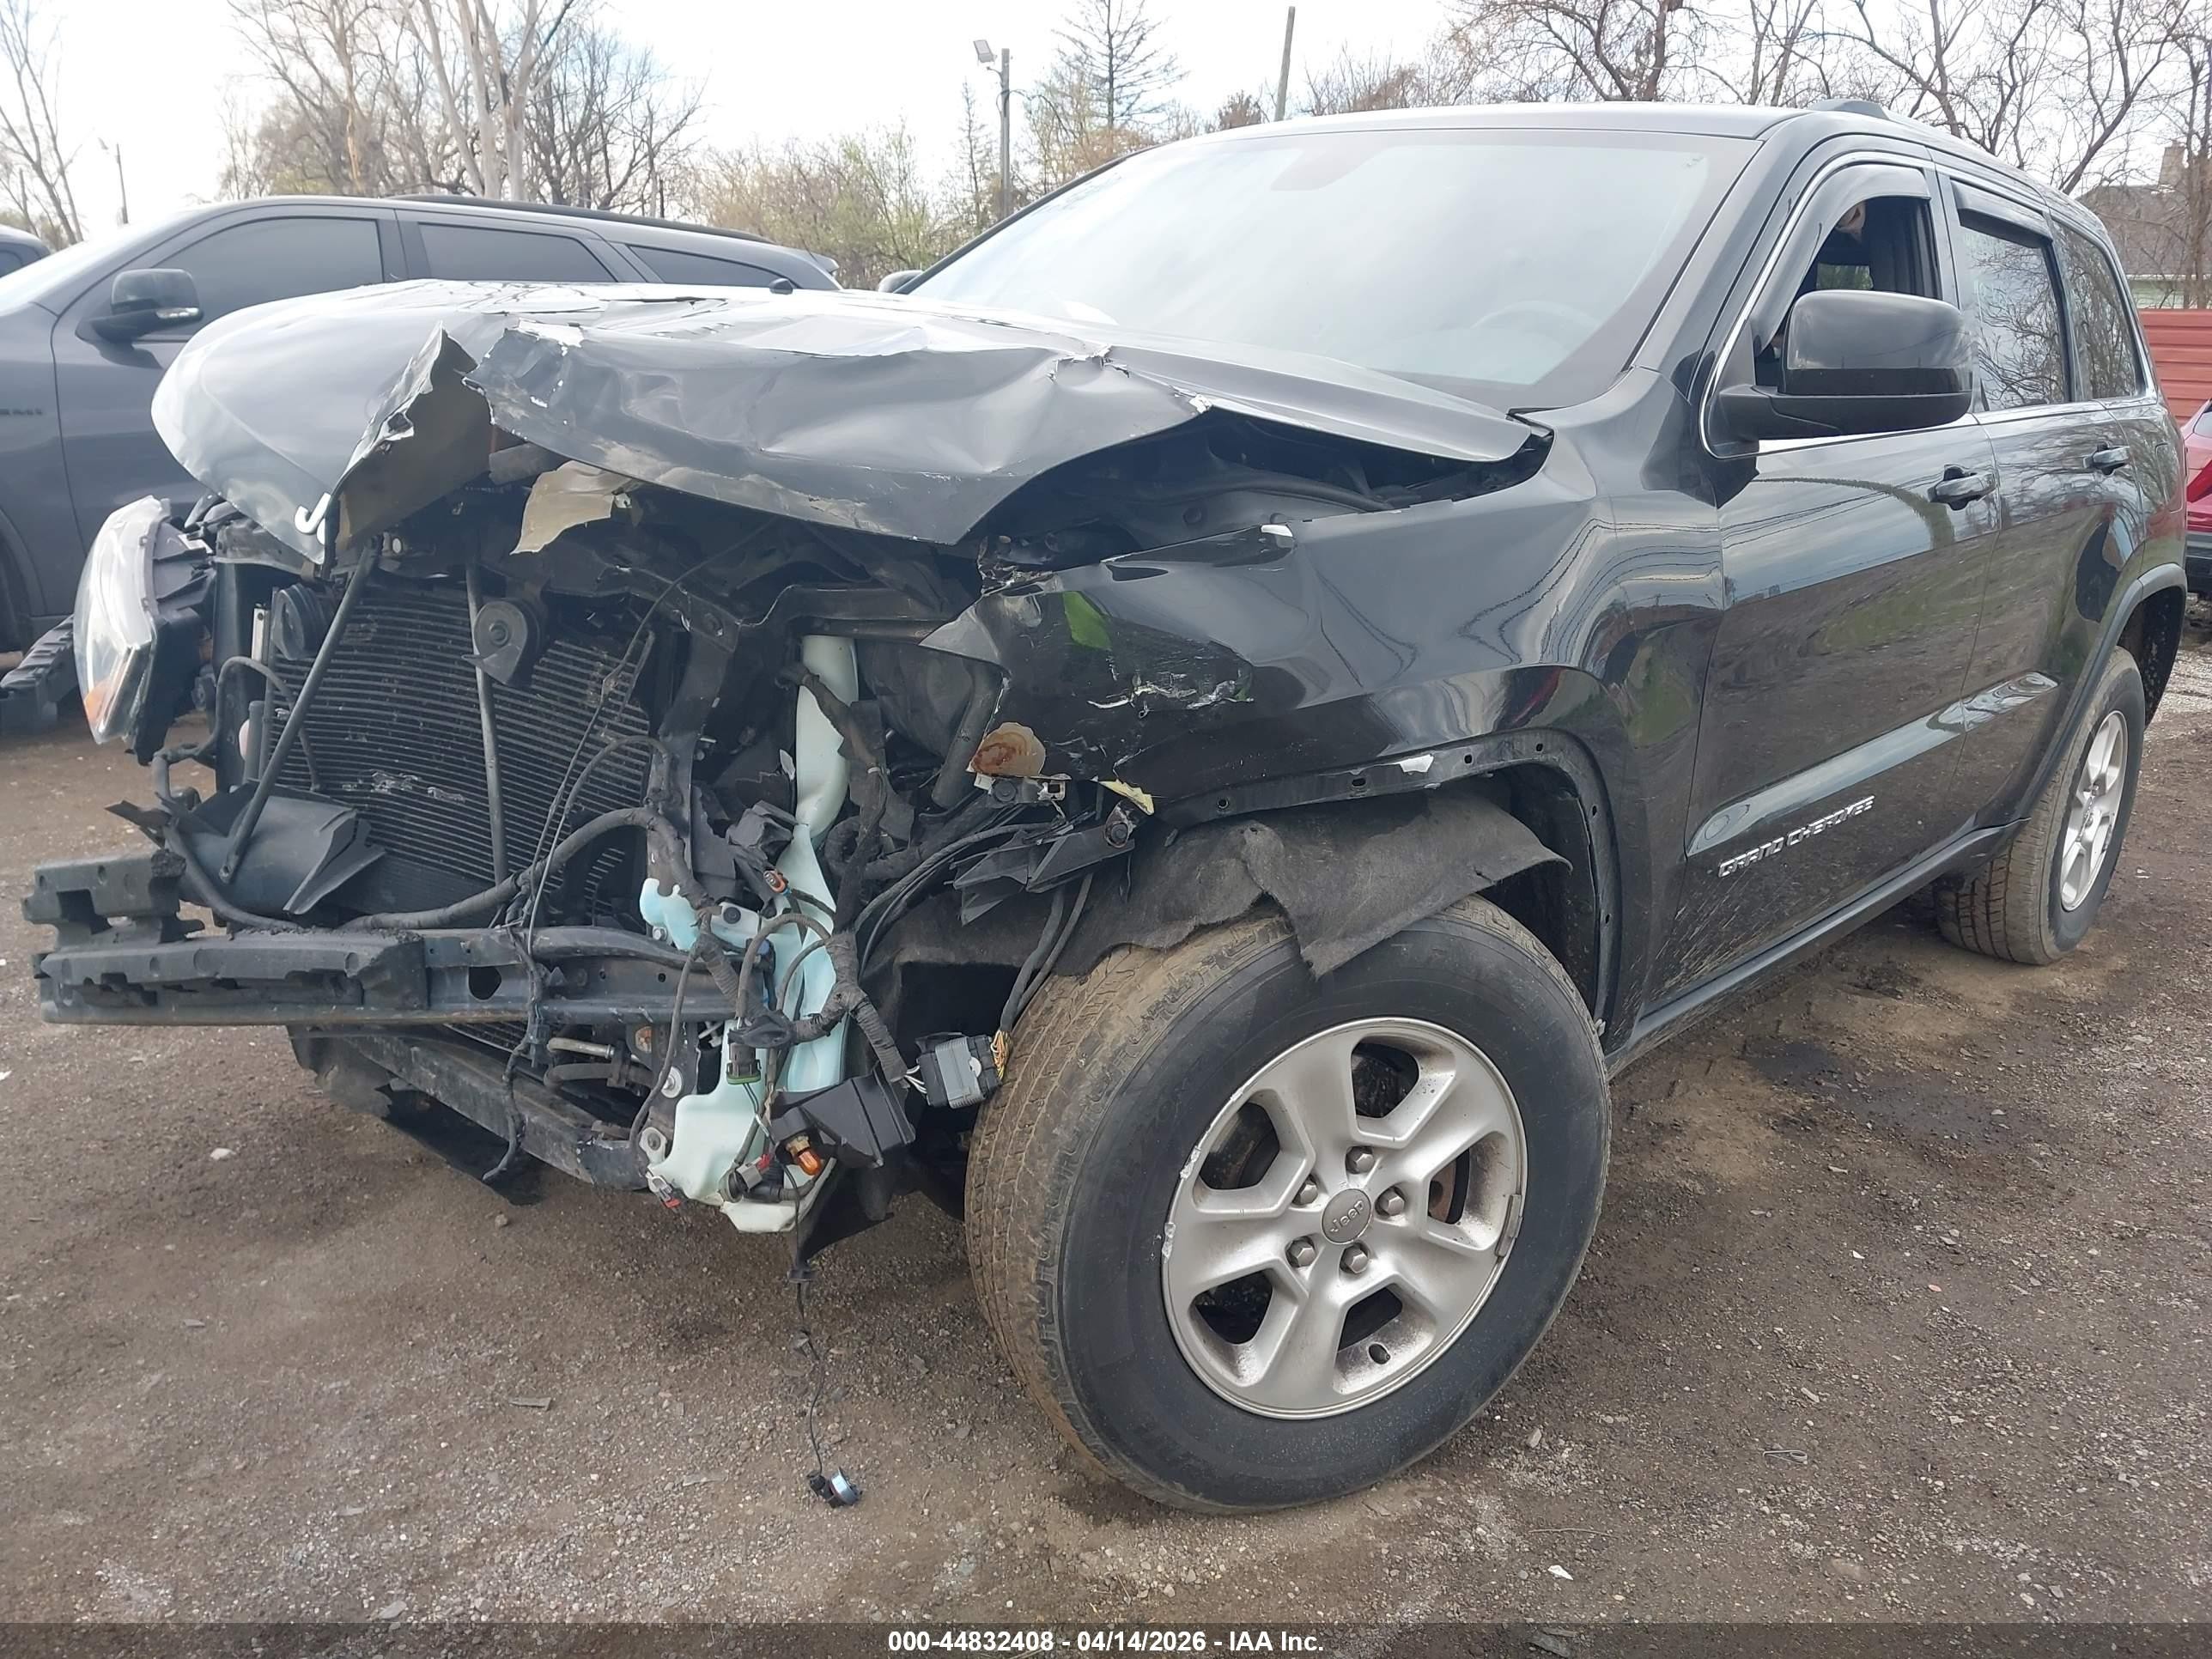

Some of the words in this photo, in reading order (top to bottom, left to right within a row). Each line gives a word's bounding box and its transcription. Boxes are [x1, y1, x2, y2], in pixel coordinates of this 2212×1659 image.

[1717, 836, 1784, 878] GRAND
[1786, 795, 1875, 847] CHEROKEE
[1330, 1199, 1364, 1233] Jeep
